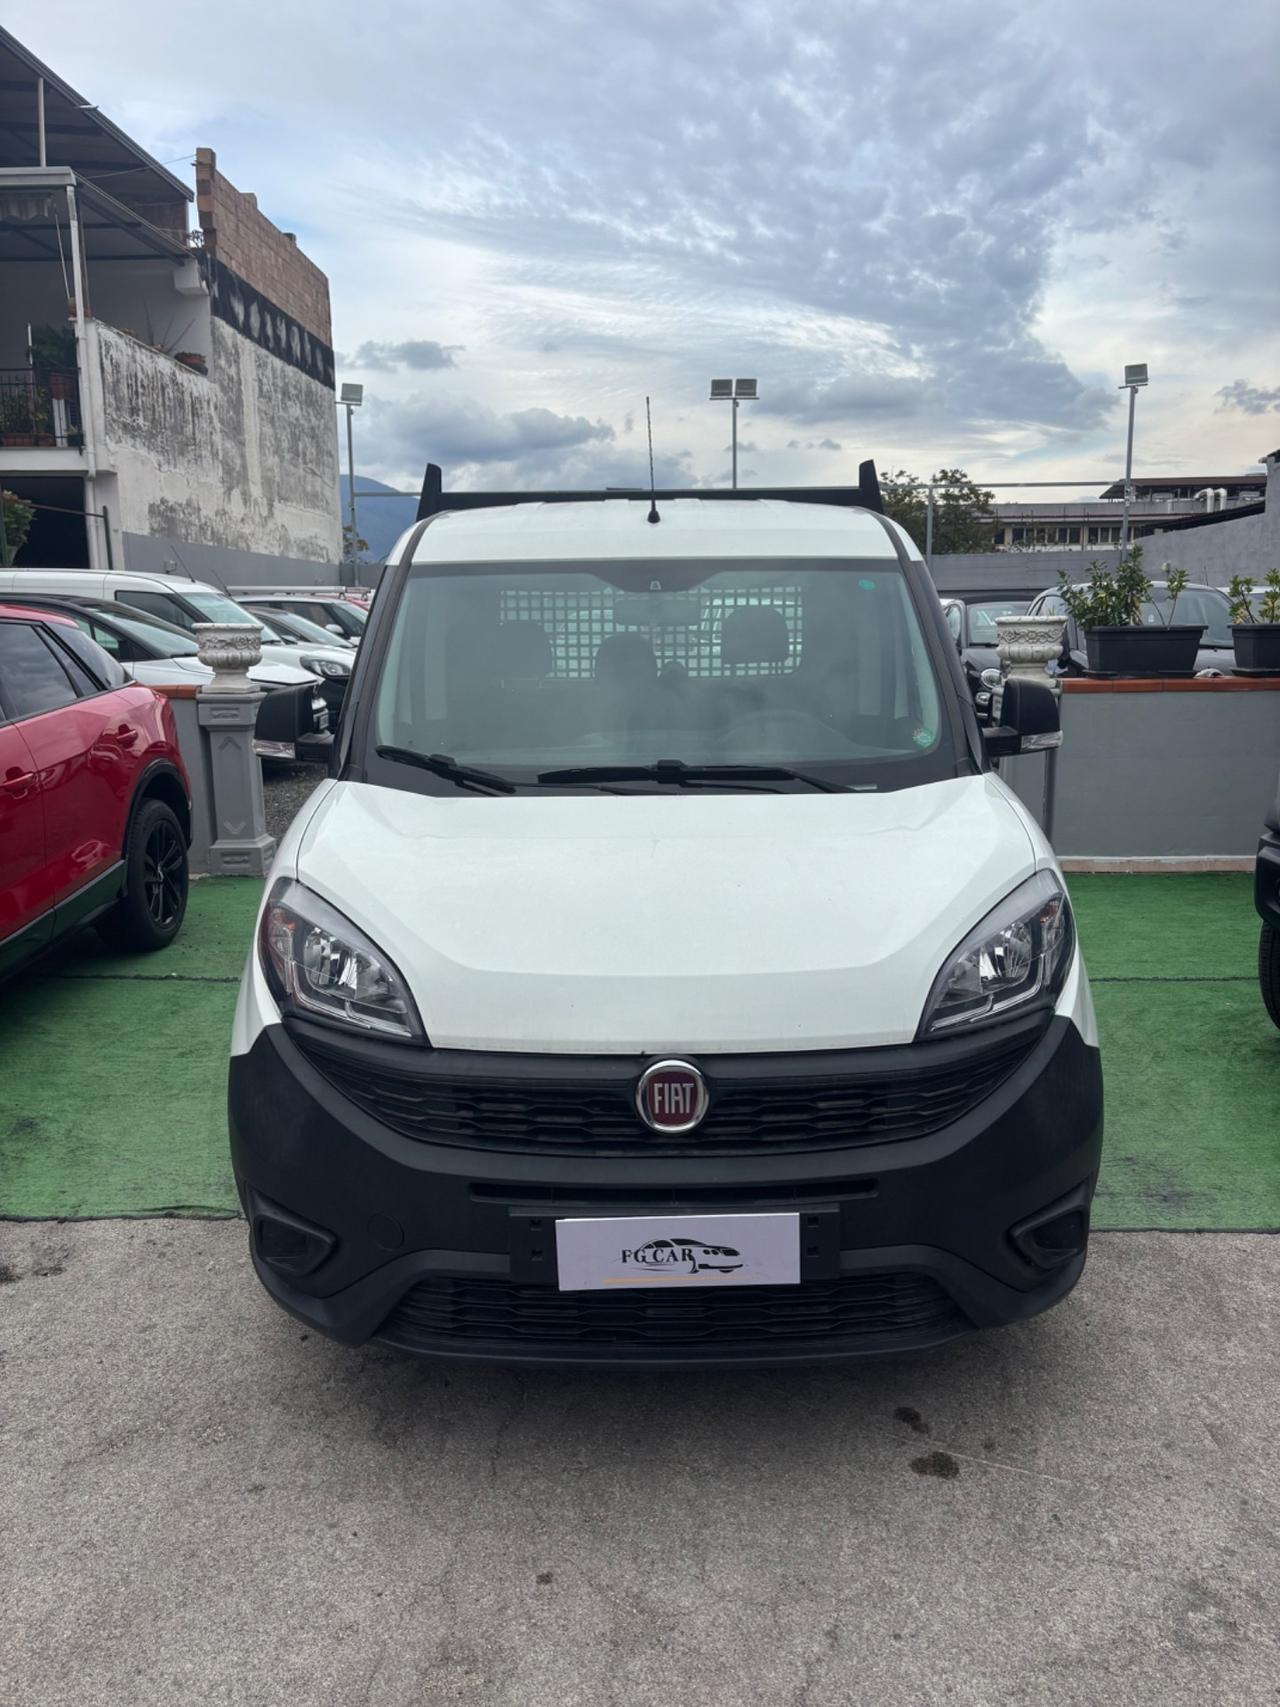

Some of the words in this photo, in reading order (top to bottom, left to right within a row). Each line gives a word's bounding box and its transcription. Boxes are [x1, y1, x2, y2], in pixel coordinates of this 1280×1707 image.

[653, 1083, 695, 1114] FIAT
[621, 1249, 647, 1263] FG
[652, 1248, 694, 1263] CAR
